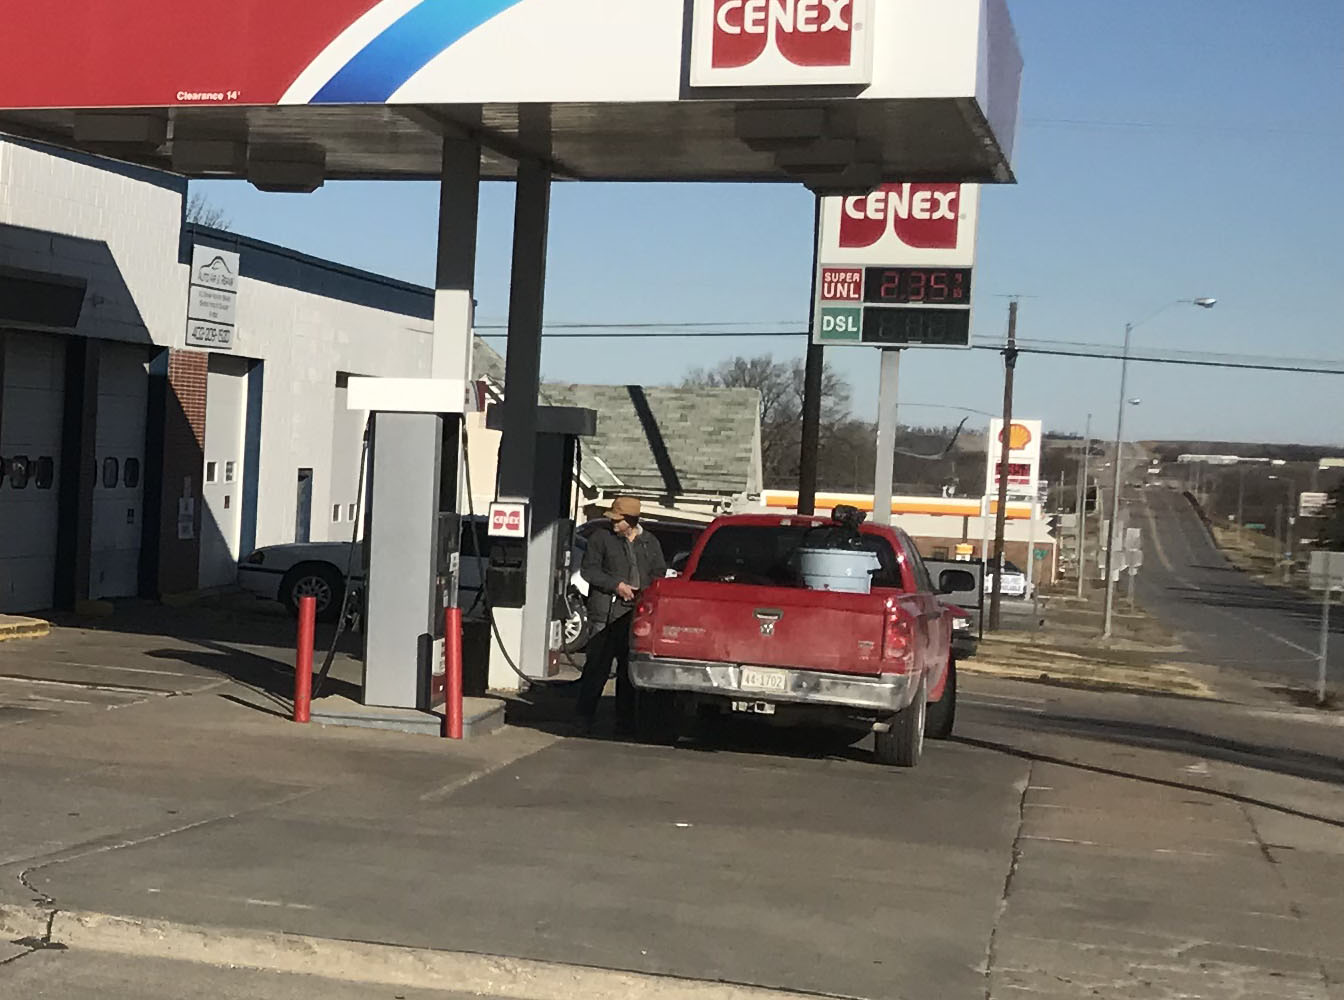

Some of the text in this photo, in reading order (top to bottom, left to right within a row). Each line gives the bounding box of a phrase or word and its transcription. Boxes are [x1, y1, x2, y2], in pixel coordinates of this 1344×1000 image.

[176, 90, 224, 101] Clearance
[844, 190, 958, 220] CENEX
[824, 272, 861, 283] SUPER
[823, 282, 860, 299] UNL
[822, 315, 859, 333] DSL
